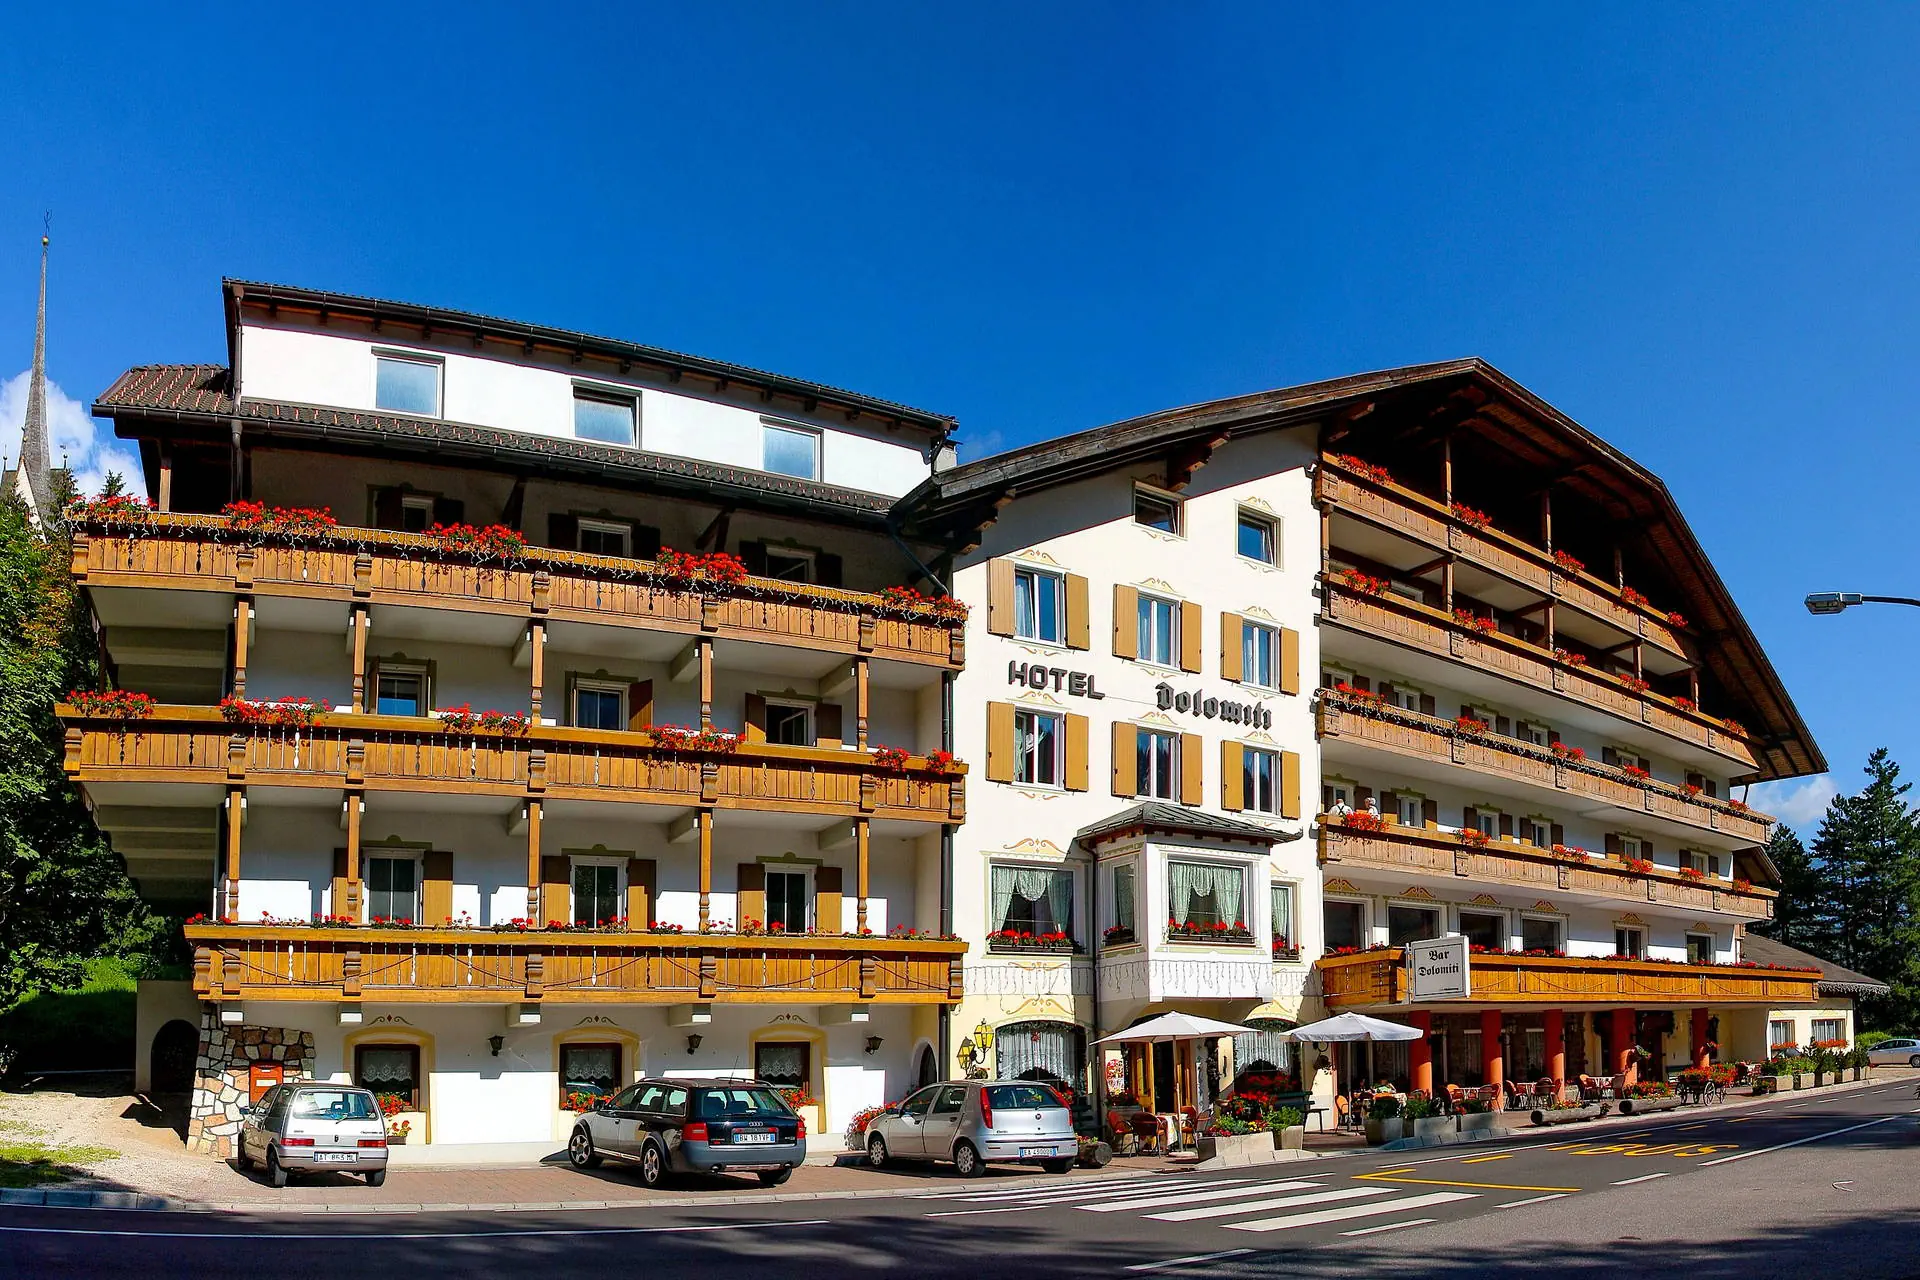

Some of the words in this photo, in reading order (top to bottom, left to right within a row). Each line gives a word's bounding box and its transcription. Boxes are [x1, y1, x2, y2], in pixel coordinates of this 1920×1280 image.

[1008, 660, 1105, 700] HOTEL
[1155, 681, 1272, 730] Dolomiti
[1429, 950, 1449, 961] Bar
[1418, 963, 1459, 976] Dolomiti
[1569, 1143, 1739, 1157] BUS
